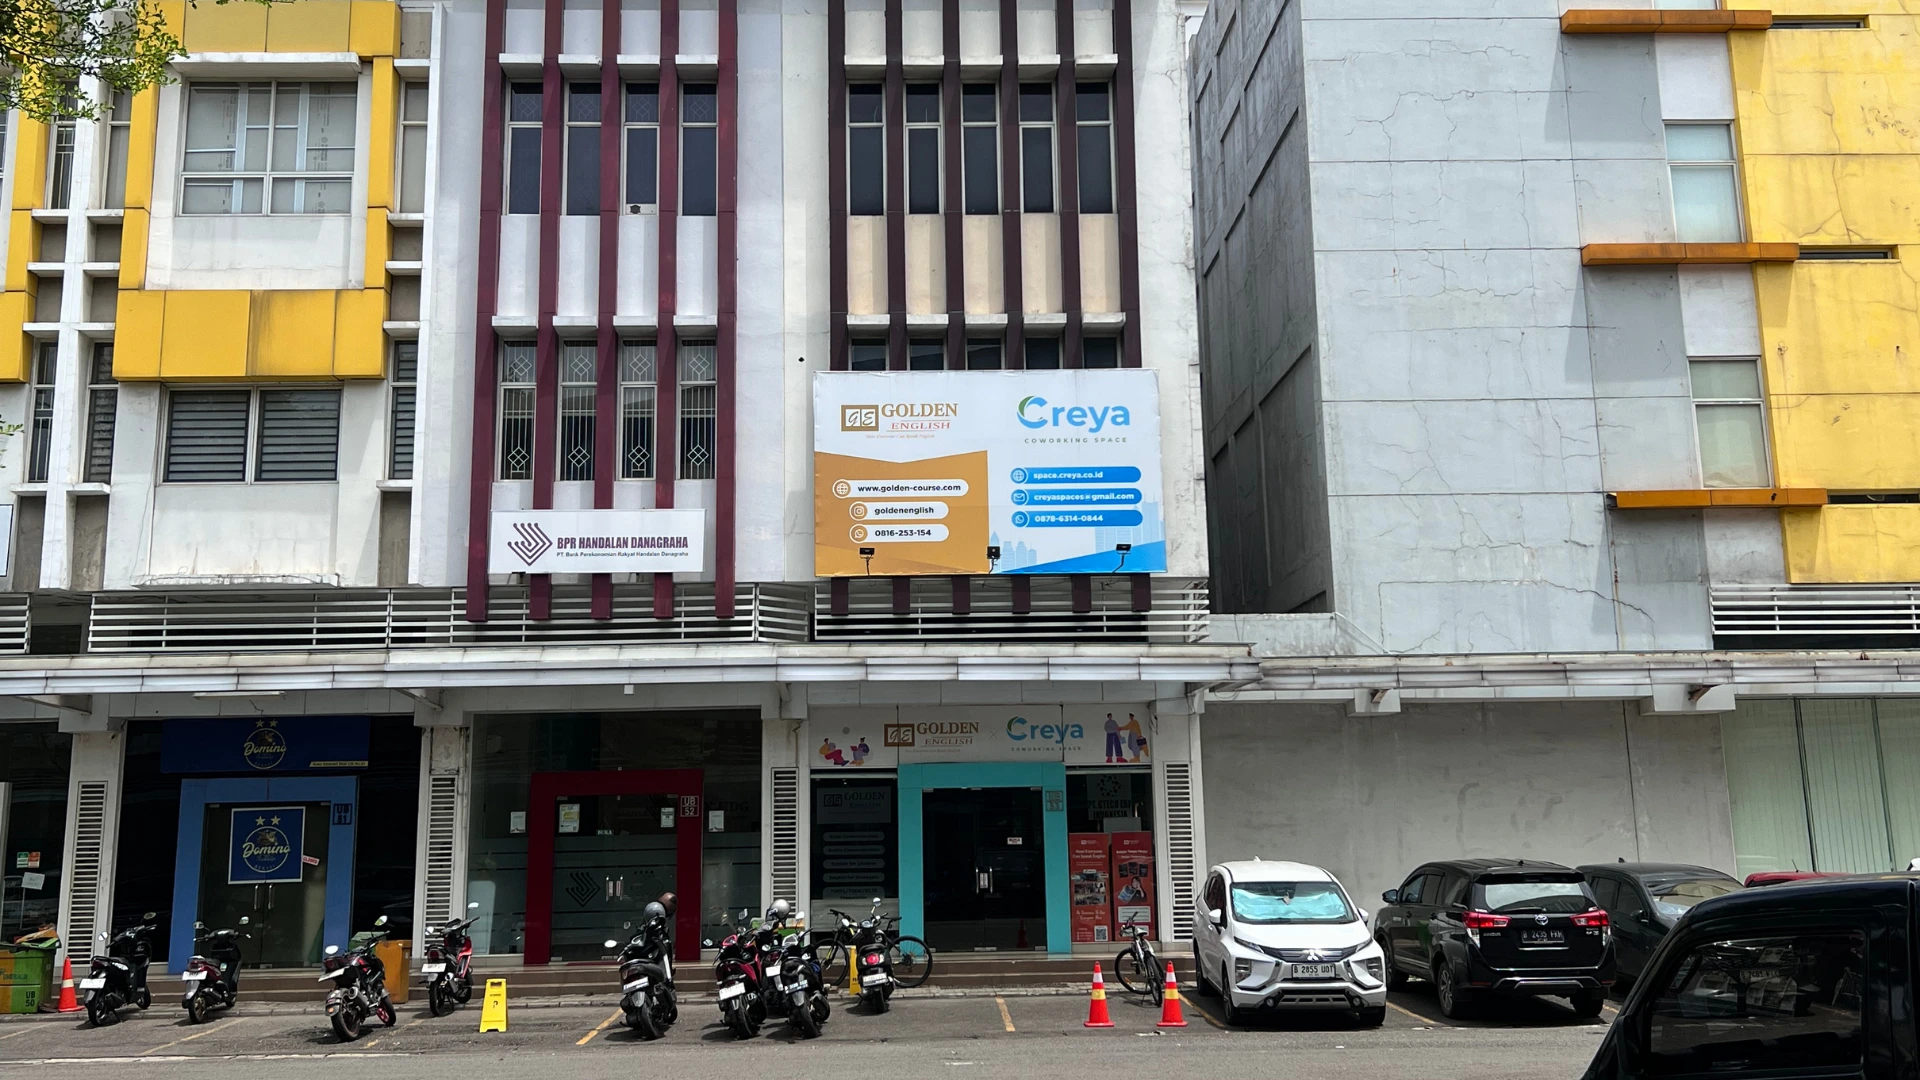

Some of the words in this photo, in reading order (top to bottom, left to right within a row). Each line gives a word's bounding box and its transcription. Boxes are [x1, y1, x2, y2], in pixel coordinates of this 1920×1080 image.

[881, 403, 958, 418] GOLDEN
[1017, 396, 1130, 433] Creya
[891, 422, 950, 430] ENGLISH
[1033, 471, 1104, 480] space.creya.co.id
[858, 484, 961, 494] www.golden-course.com
[874, 506, 934, 515] goldenenglish
[1034, 514, 1104, 522] 0878-6314-0844
[875, 529, 932, 537] 0816-253-154
[557, 538, 577, 549] BPR
[579, 537, 629, 549] HANDALAN
[631, 537, 688, 549] DANAGRAHA
[917, 722, 980, 734] GOLDEN
[1006, 716, 1084, 744] Creya
[244, 742, 287, 756] Domino
[684, 796, 696, 805] UB
[337, 805, 349, 814] UB
[684, 807, 695, 816] 52
[338, 815, 347, 823] 51
[242, 841, 291, 858] Domino
